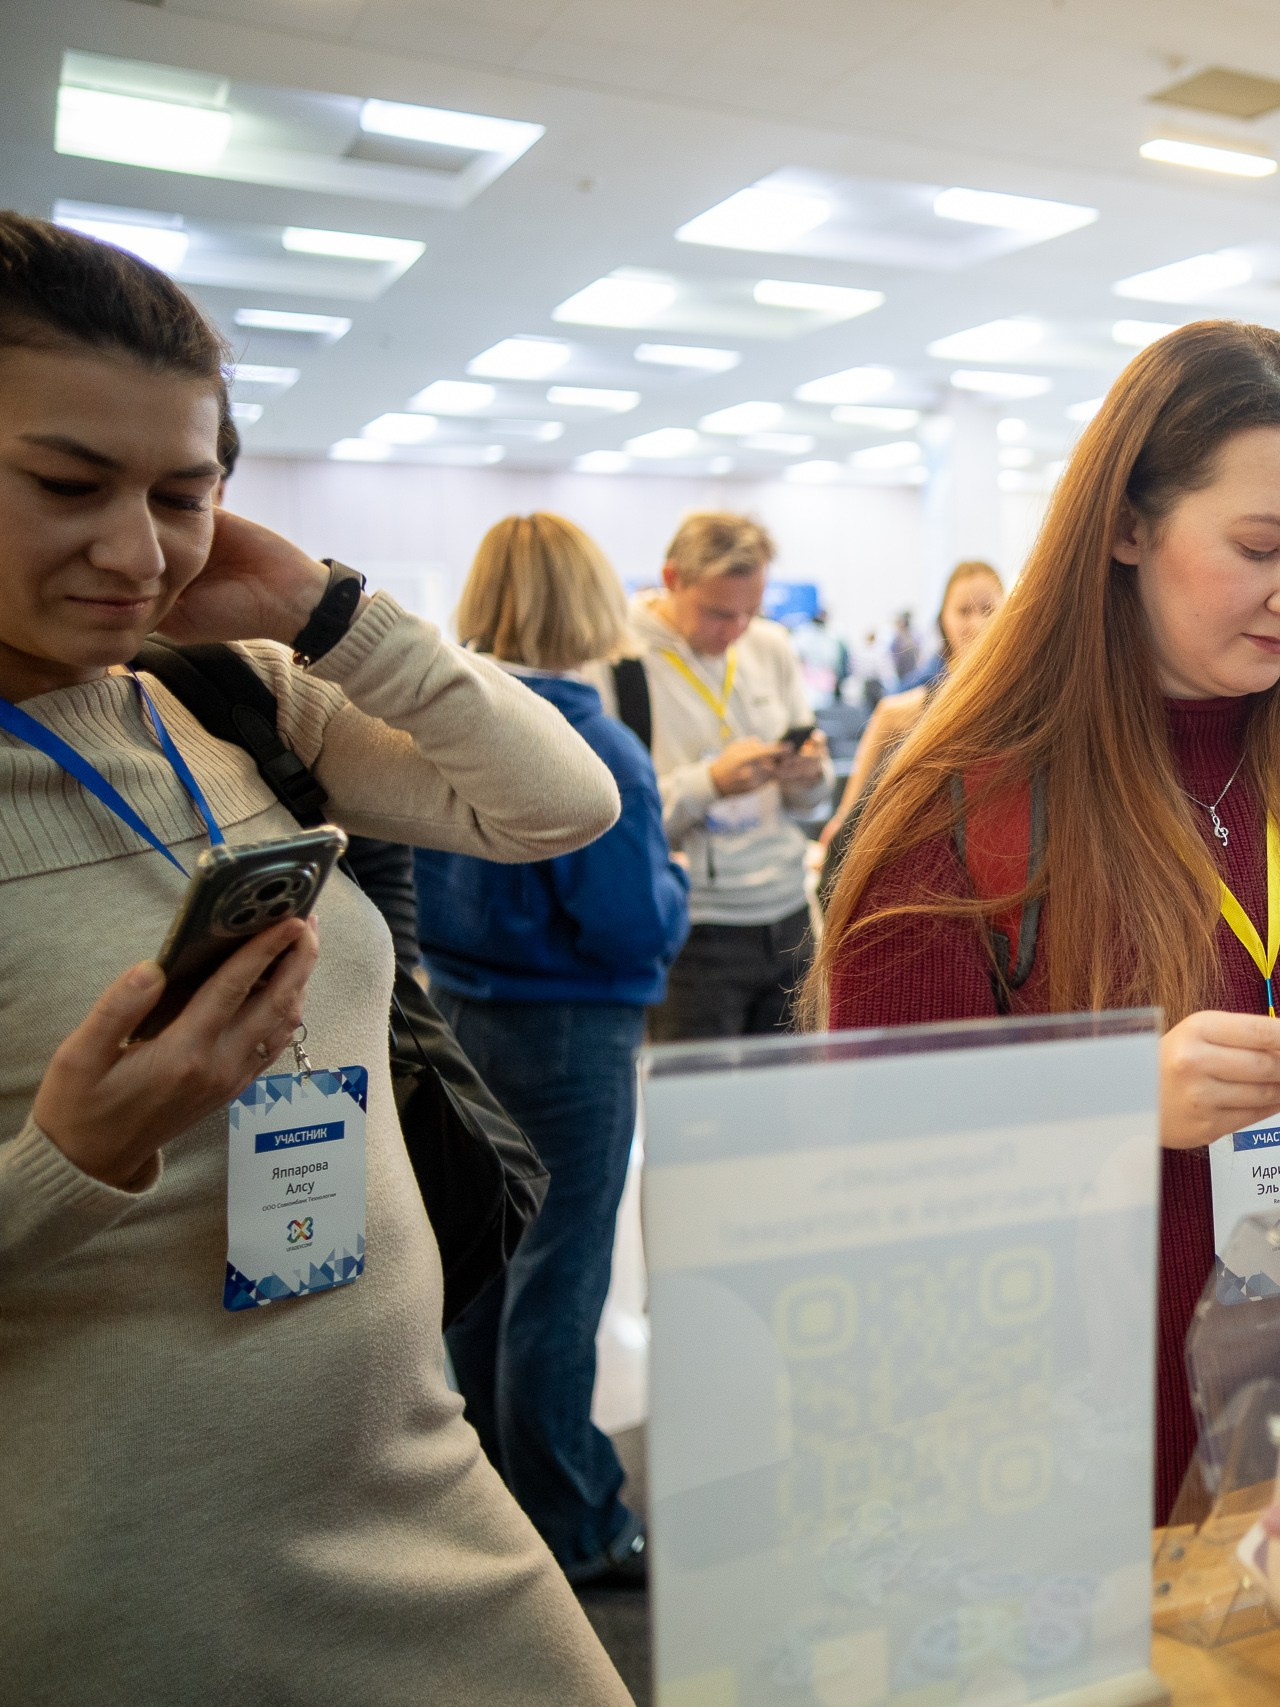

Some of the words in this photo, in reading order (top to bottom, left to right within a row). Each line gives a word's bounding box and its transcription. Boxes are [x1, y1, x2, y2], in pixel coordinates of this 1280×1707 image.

[275, 1128, 327, 1146] УЧАСТНИК
[272, 1161, 328, 1180] Яппарова
[285, 1181, 315, 1196] Алсу
